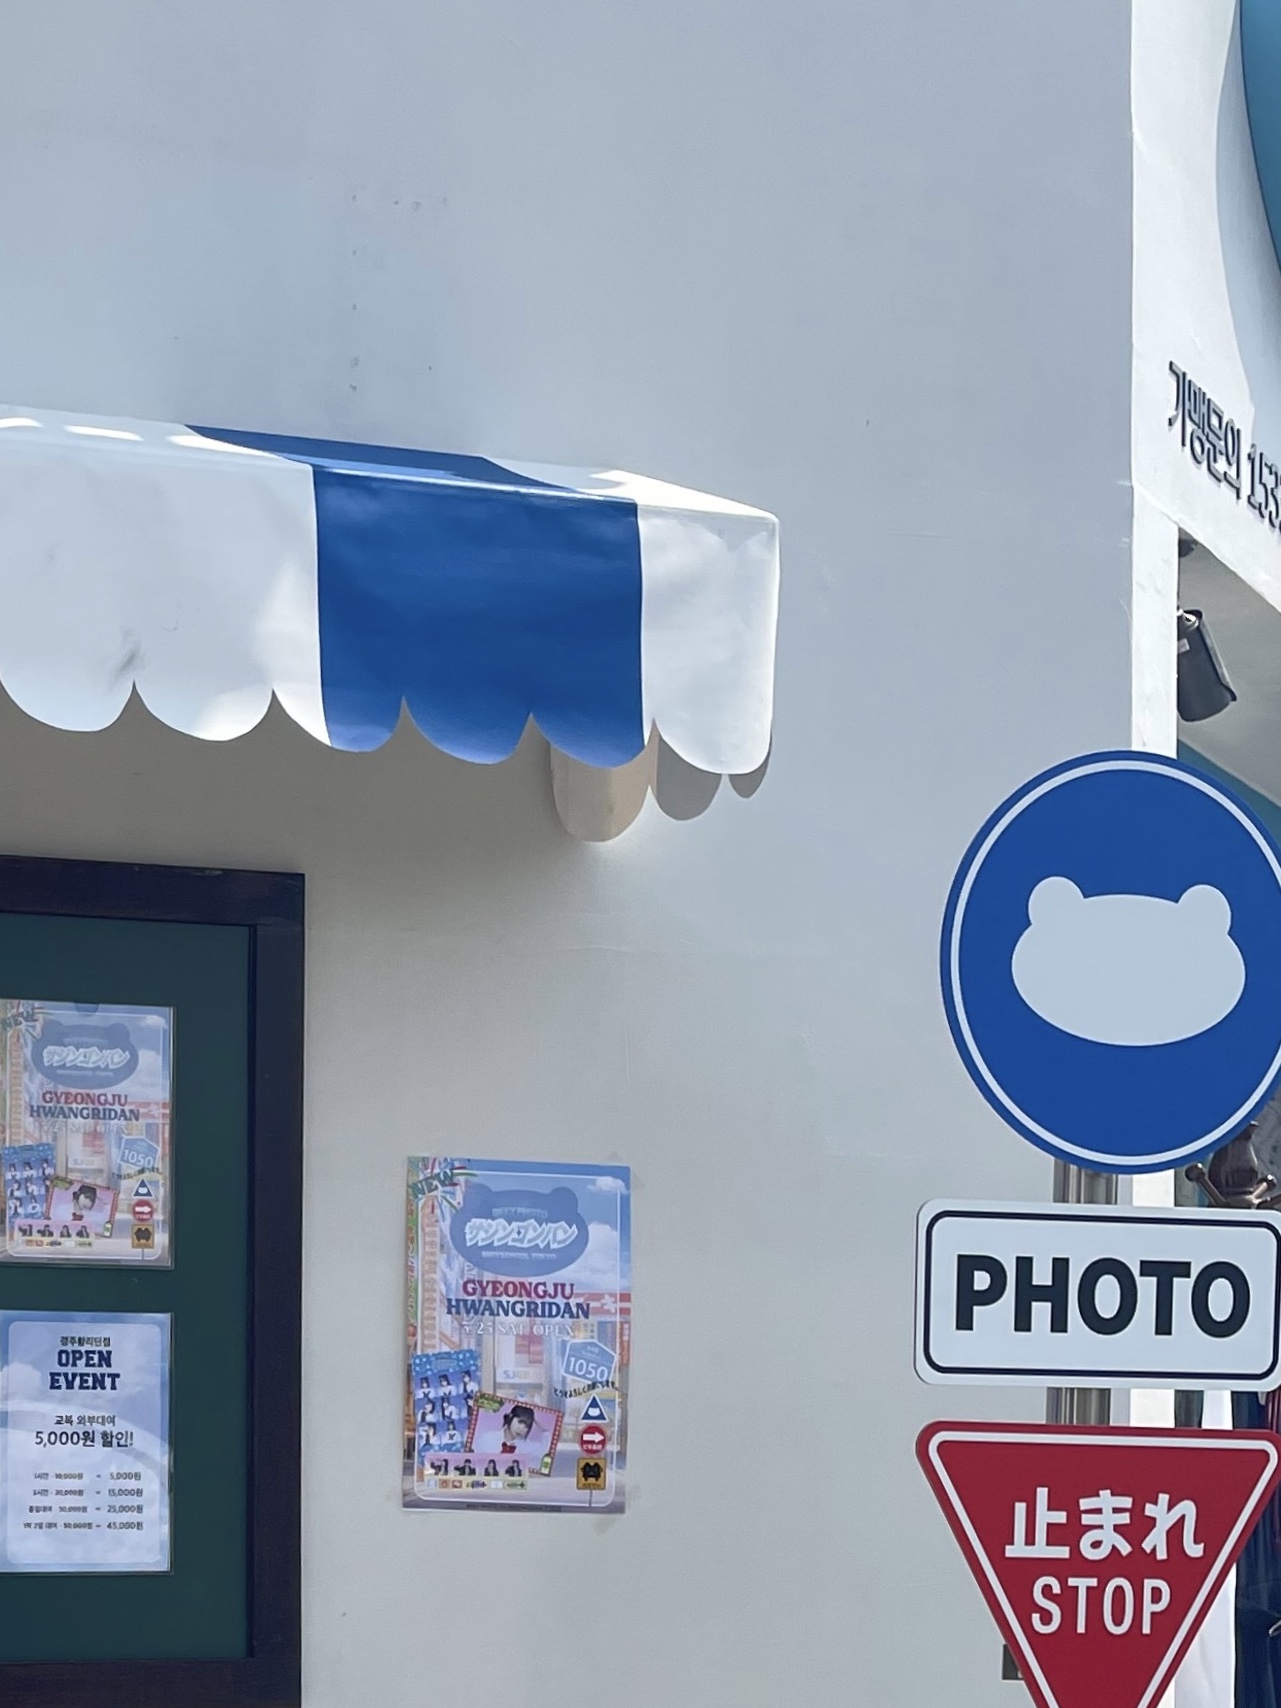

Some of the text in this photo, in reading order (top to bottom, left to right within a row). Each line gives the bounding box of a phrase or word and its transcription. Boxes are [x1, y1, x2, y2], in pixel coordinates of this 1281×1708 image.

[1168, 360, 1281, 535] 가맹문의 153
[42, 1091, 128, 1107] GYEONGJU
[29, 1104, 140, 1122] HWANGRIDAN
[122, 1149, 154, 1169] 1050
[411, 1168, 454, 1199] NEW
[462, 1280, 575, 1300] GYEONGJU
[955, 1253, 1251, 1339] PHOTO
[446, 1299, 590, 1319] HWANGRIDAN
[60, 1336, 111, 1347] 경주황리단점
[57, 1350, 113, 1368] OPEN
[569, 1356, 609, 1383] 1050
[49, 1372, 121, 1391] EVENT
[34, 1430, 134, 1448] 5,000원 할인!
[1005, 1486, 1205, 1561] 止まれ
[1031, 1575, 1171, 1635] STOP
